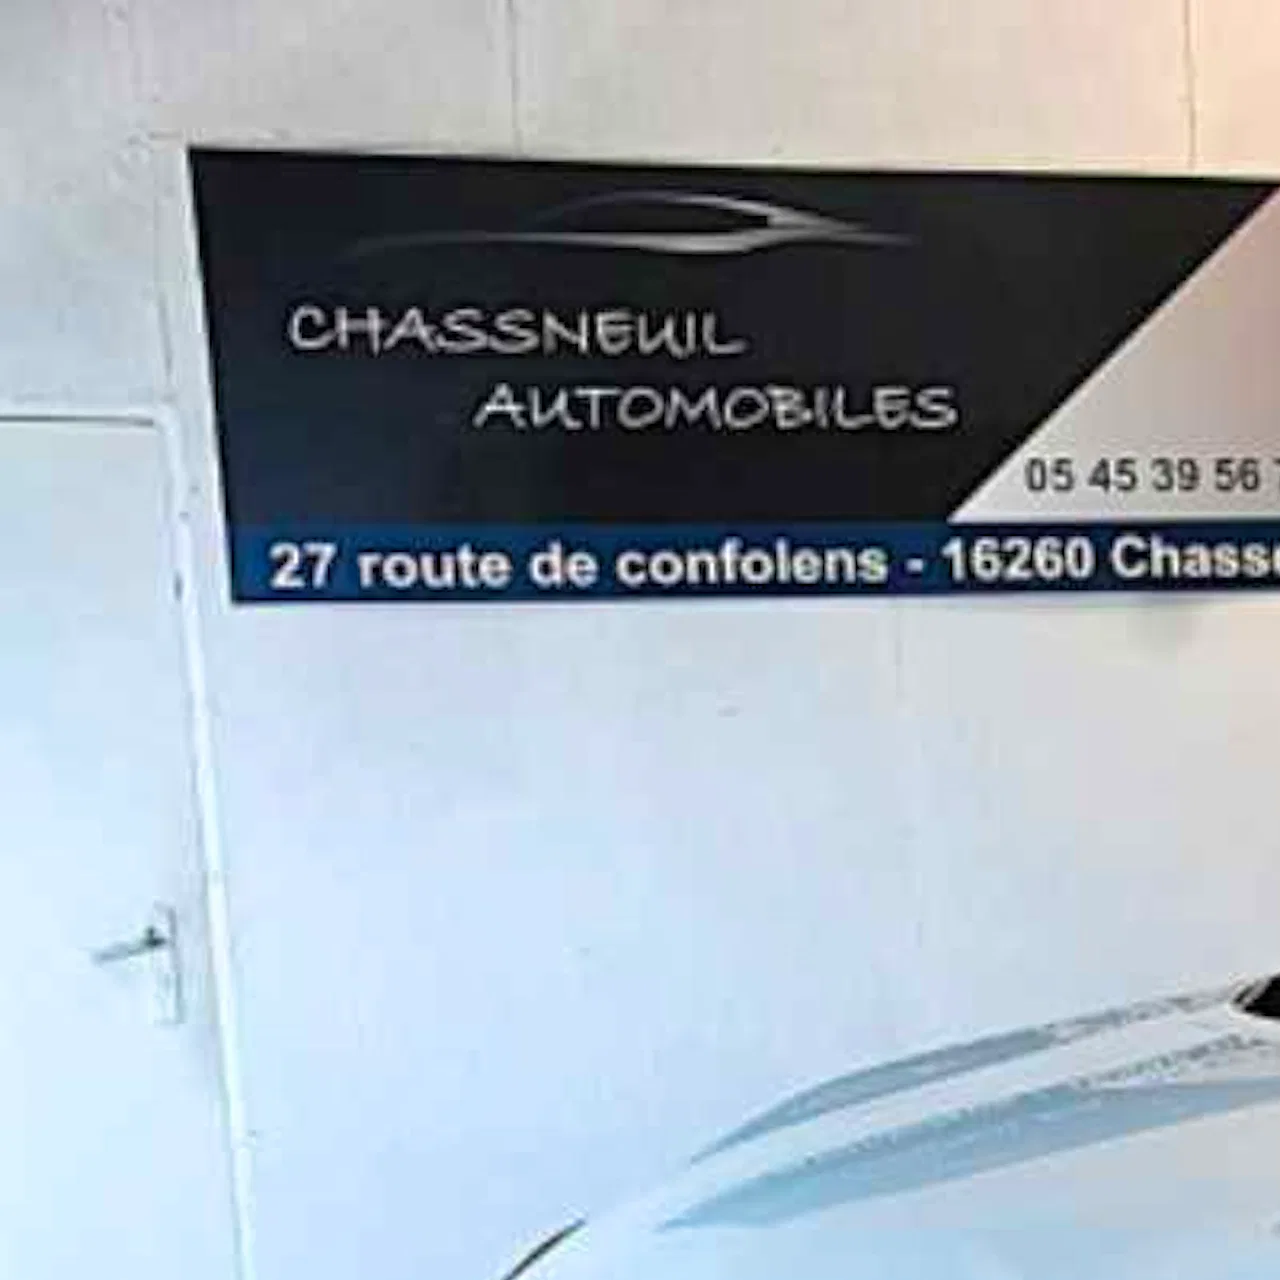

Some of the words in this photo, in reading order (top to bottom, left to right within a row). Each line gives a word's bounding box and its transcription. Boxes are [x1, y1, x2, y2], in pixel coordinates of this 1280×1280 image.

[288, 304, 748, 358] CHASSNEUIL
[472, 382, 958, 432] AUTOMOBILES
[1025, 456, 1076, 491] 05
[1087, 456, 1138, 491] 45
[1151, 456, 1200, 491] 39
[1214, 456, 1262, 491] 56
[267, 542, 338, 591] 27
[356, 543, 512, 589] route
[528, 541, 598, 587] de
[614, 537, 889, 586] confolens
[940, 535, 1096, 583] 16260
